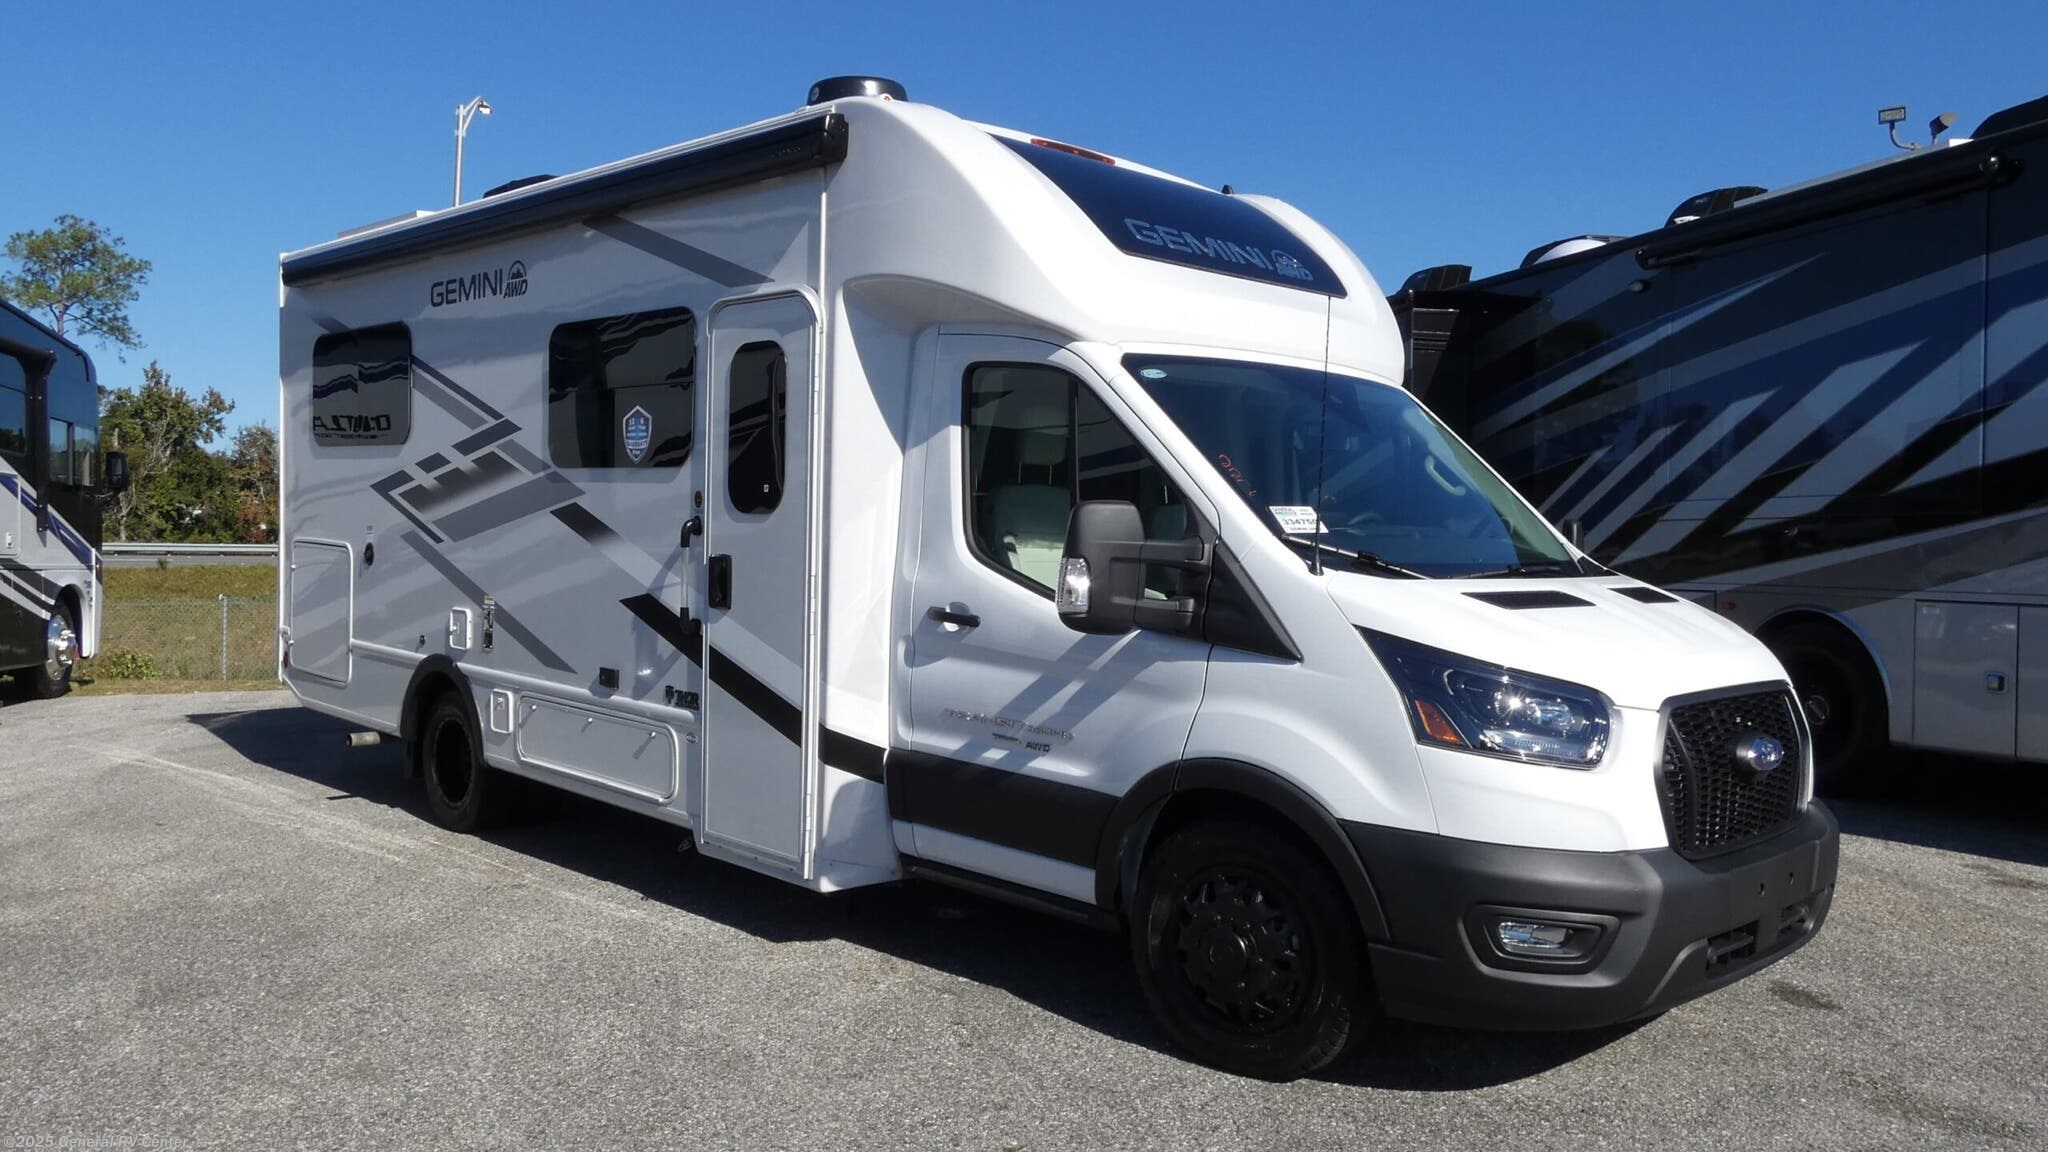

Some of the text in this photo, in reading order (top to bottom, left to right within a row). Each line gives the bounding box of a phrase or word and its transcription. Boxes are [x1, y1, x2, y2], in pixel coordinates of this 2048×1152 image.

[1124, 217, 1274, 271] GEMINI
[430, 268, 529, 308] GEMINI AWD
[1025, 740, 1052, 753] AWD
